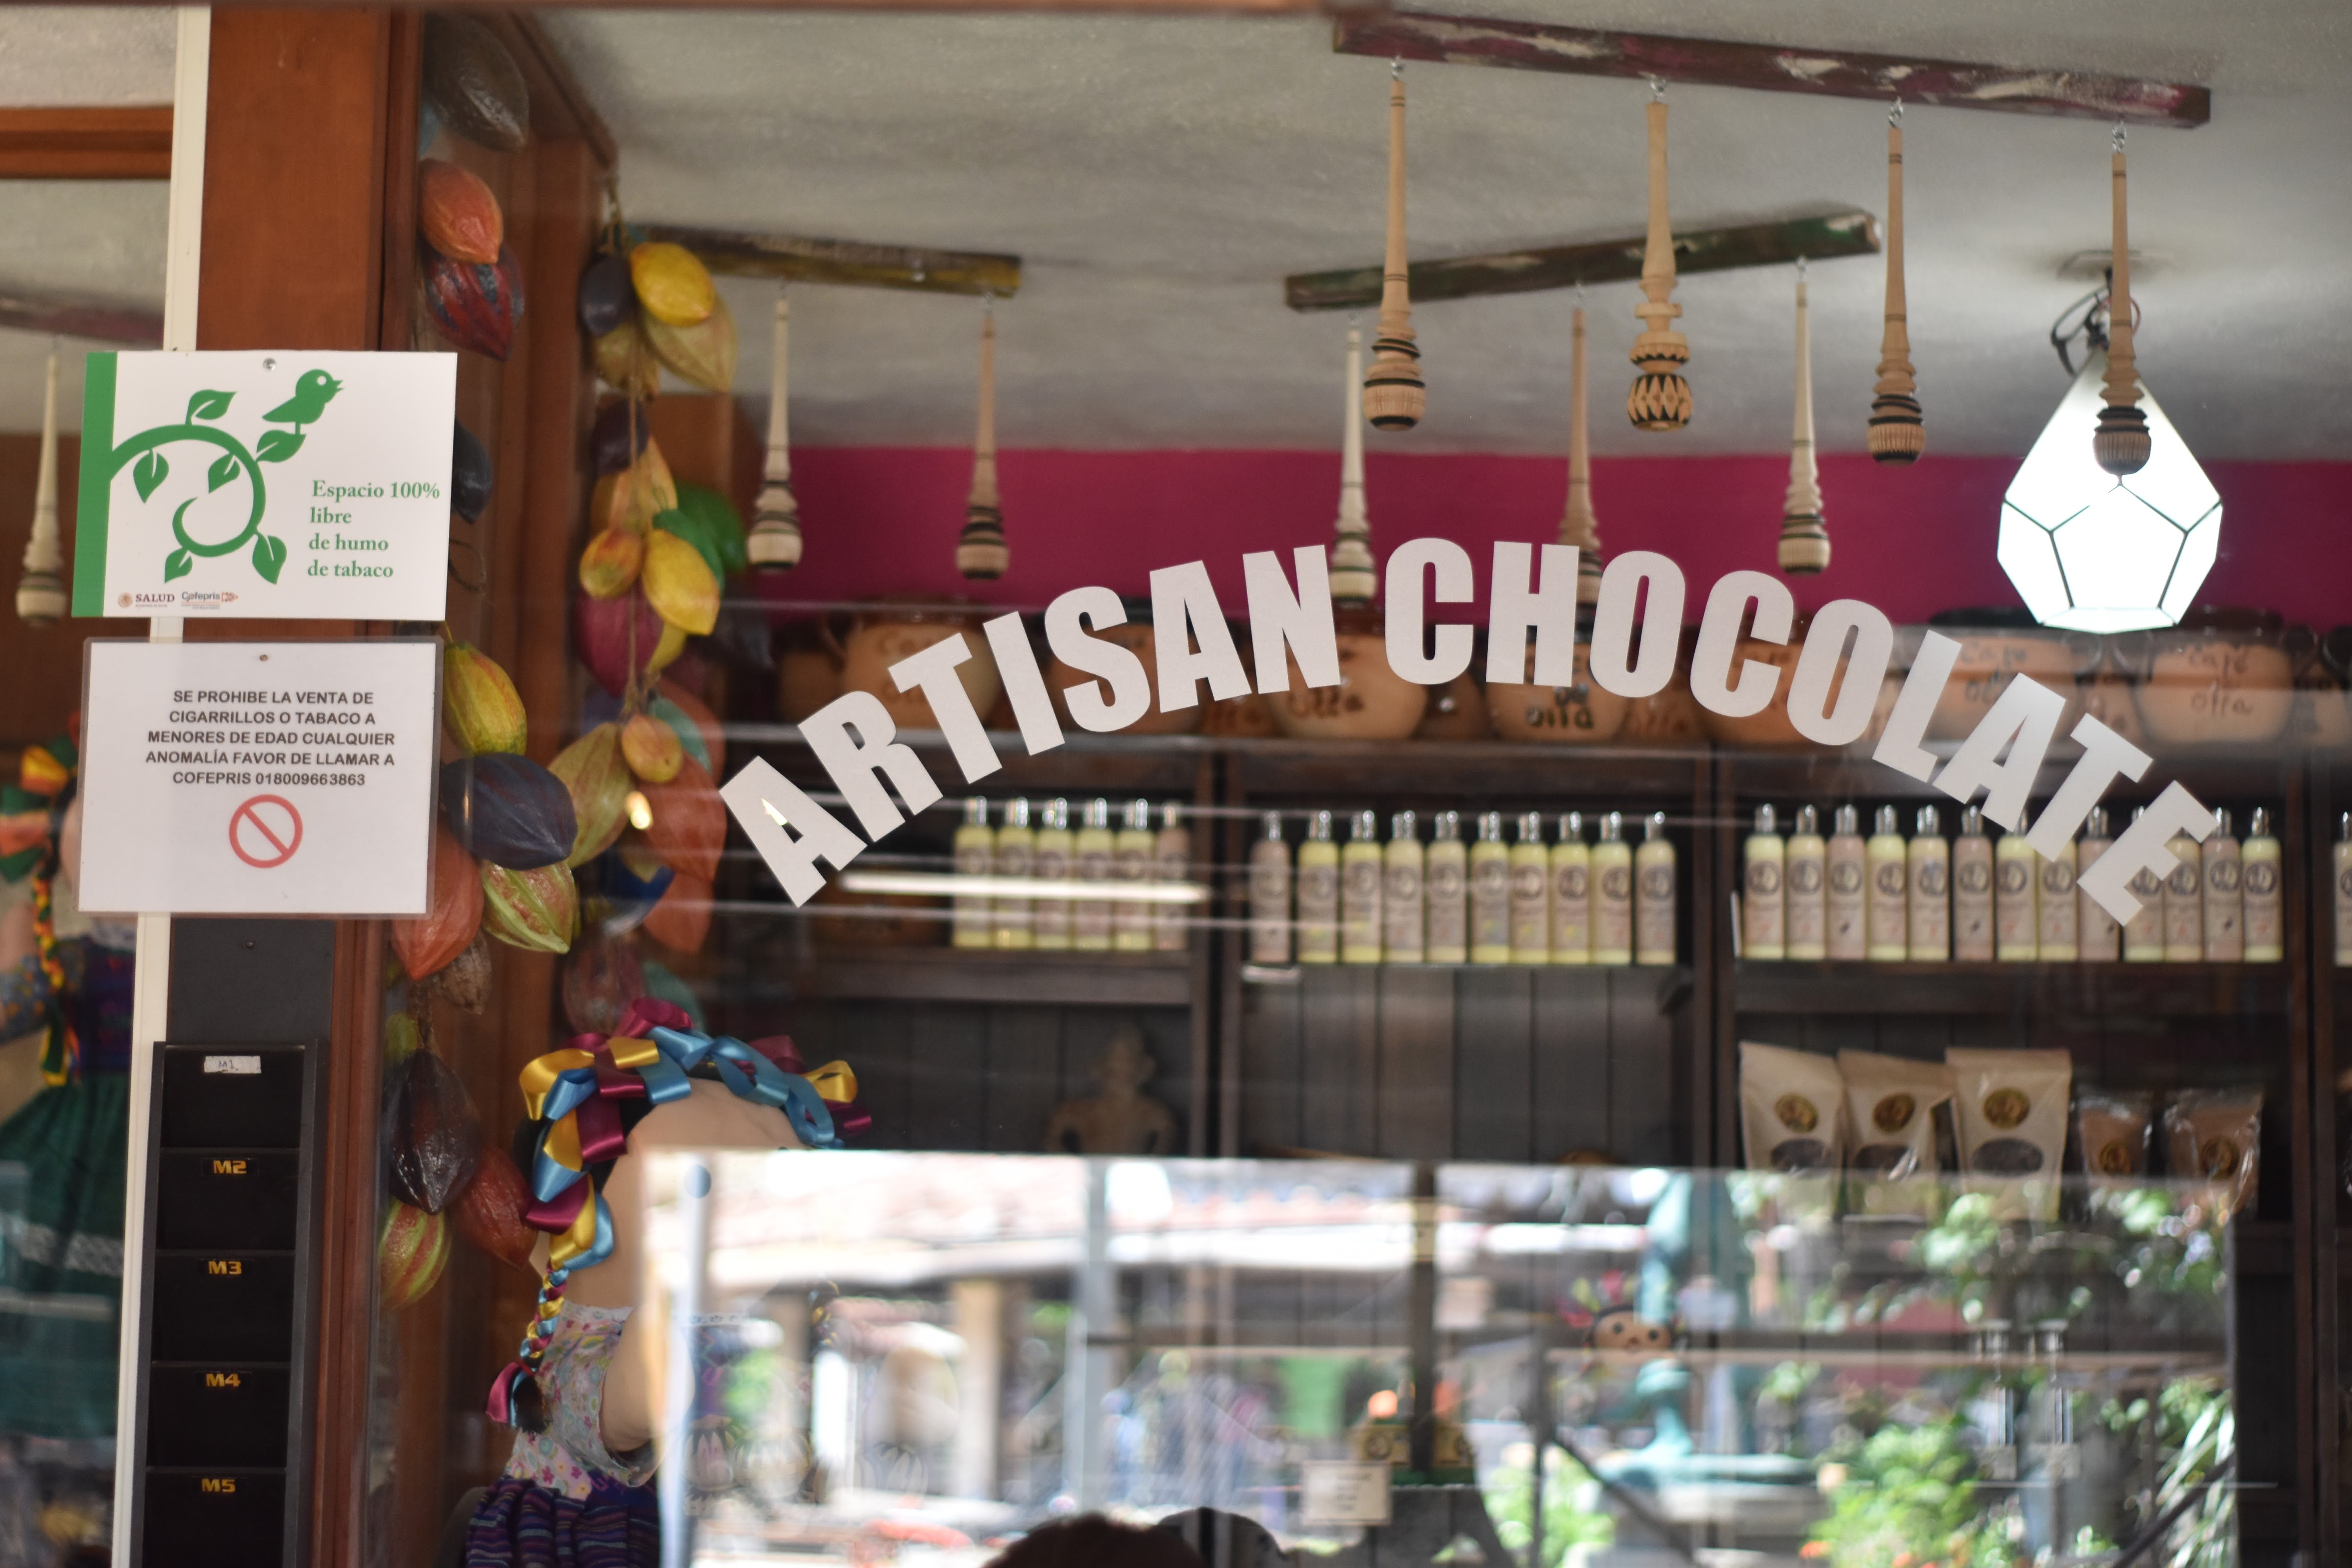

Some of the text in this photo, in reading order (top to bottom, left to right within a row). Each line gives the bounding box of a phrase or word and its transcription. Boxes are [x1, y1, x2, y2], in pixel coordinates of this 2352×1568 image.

[312, 480, 440, 503] Espacio 100%
[310, 506, 352, 524] libre
[309, 533, 389, 551] de humo
[307, 560, 394, 578] de tabaco
[135, 591, 220, 602] SALUD Cofepris
[174, 691, 373, 705] SE PROHIBE LA VENTA DE
[170, 711, 375, 725] CIGARRILLOS O TABACO A
[148, 731, 394, 745] MENORES DE EDAD CUALQUIER
[719, 539, 2222, 926] ARTISAN CHOCOLATE
[146, 750, 394, 765] ANOMALÍA FAVOR DE LLAMAR A
[172, 772, 365, 785] COFEPRIS 018009663863
[213, 1159, 246, 1175] M2
[208, 1261, 242, 1275] M3
[206, 1373, 241, 1387] M4
[201, 1479, 236, 1493] M5
